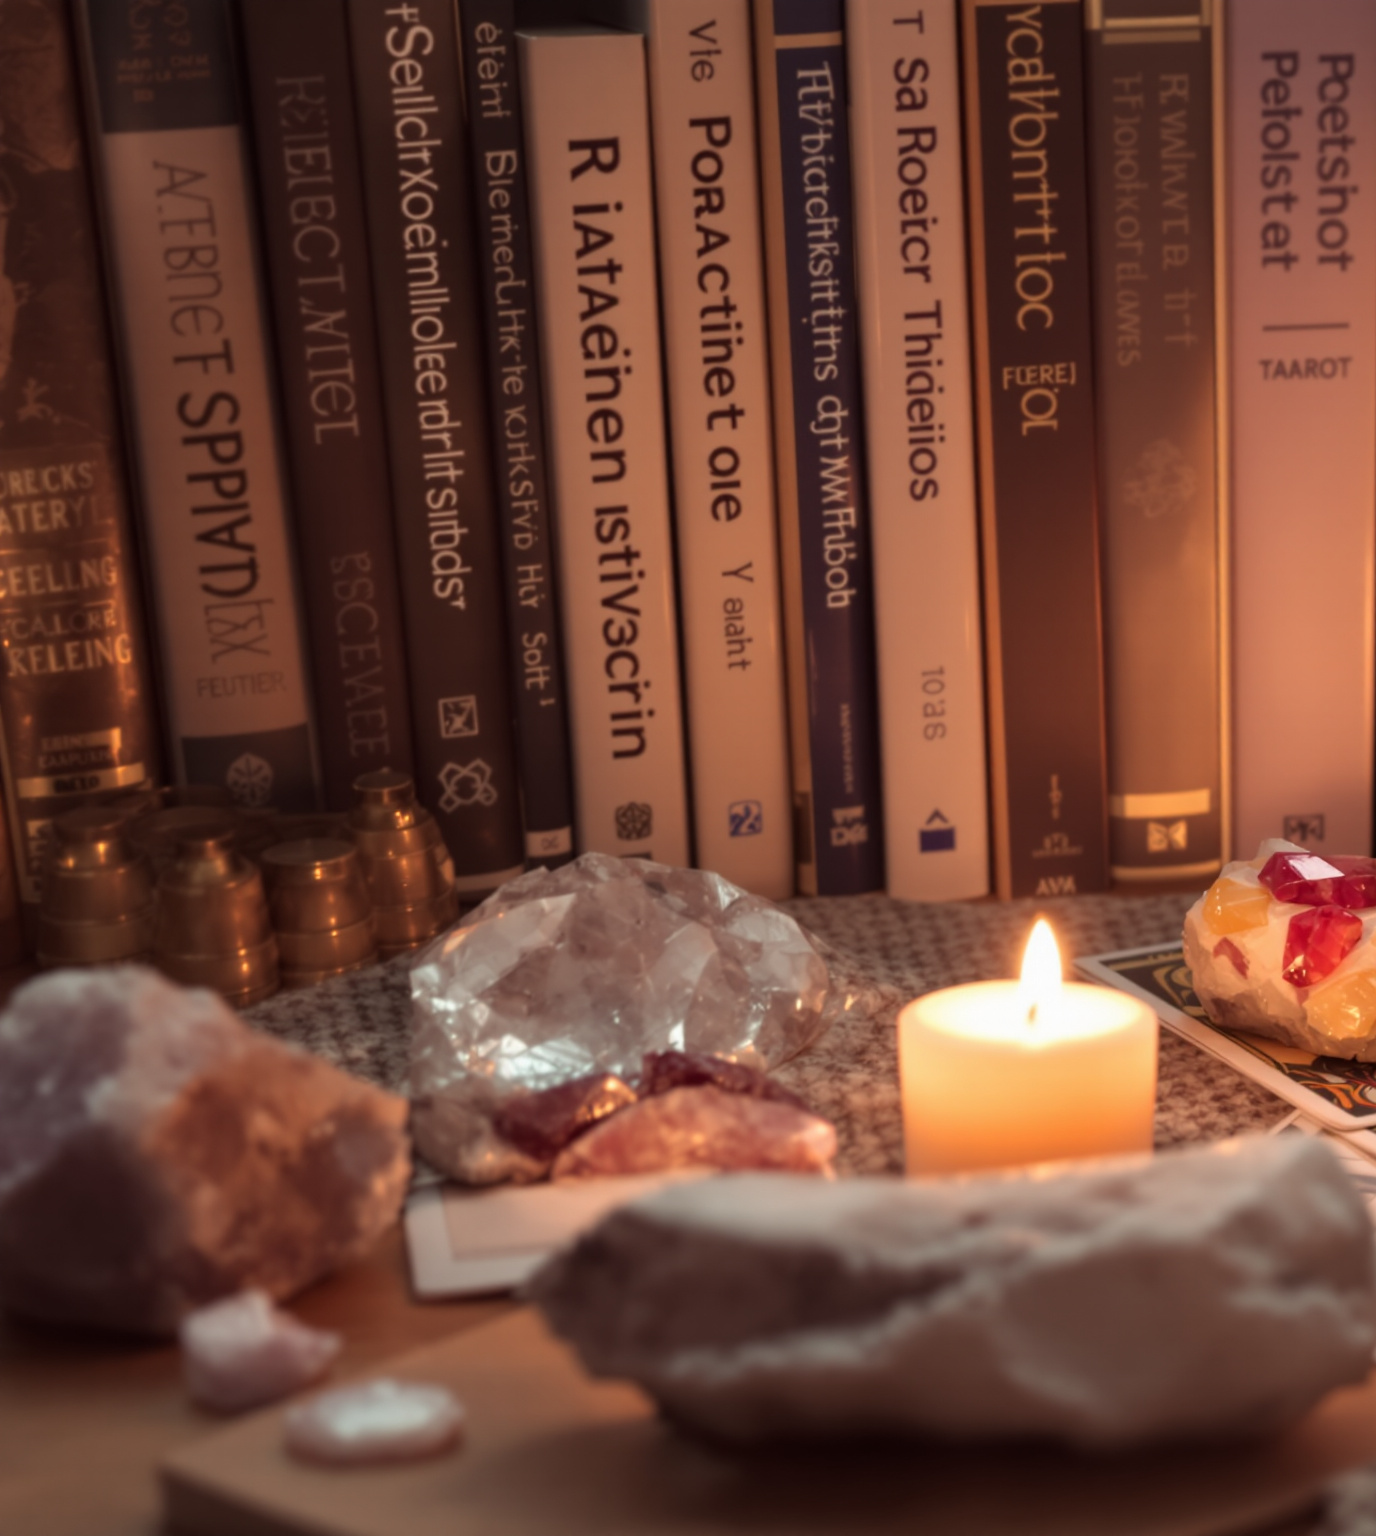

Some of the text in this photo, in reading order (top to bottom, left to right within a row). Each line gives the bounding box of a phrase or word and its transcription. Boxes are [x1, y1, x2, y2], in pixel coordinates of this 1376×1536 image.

[892, 9, 924, 35] T
[567, 136, 621, 183] R
[1258, 357, 1354, 381] TAAROT
